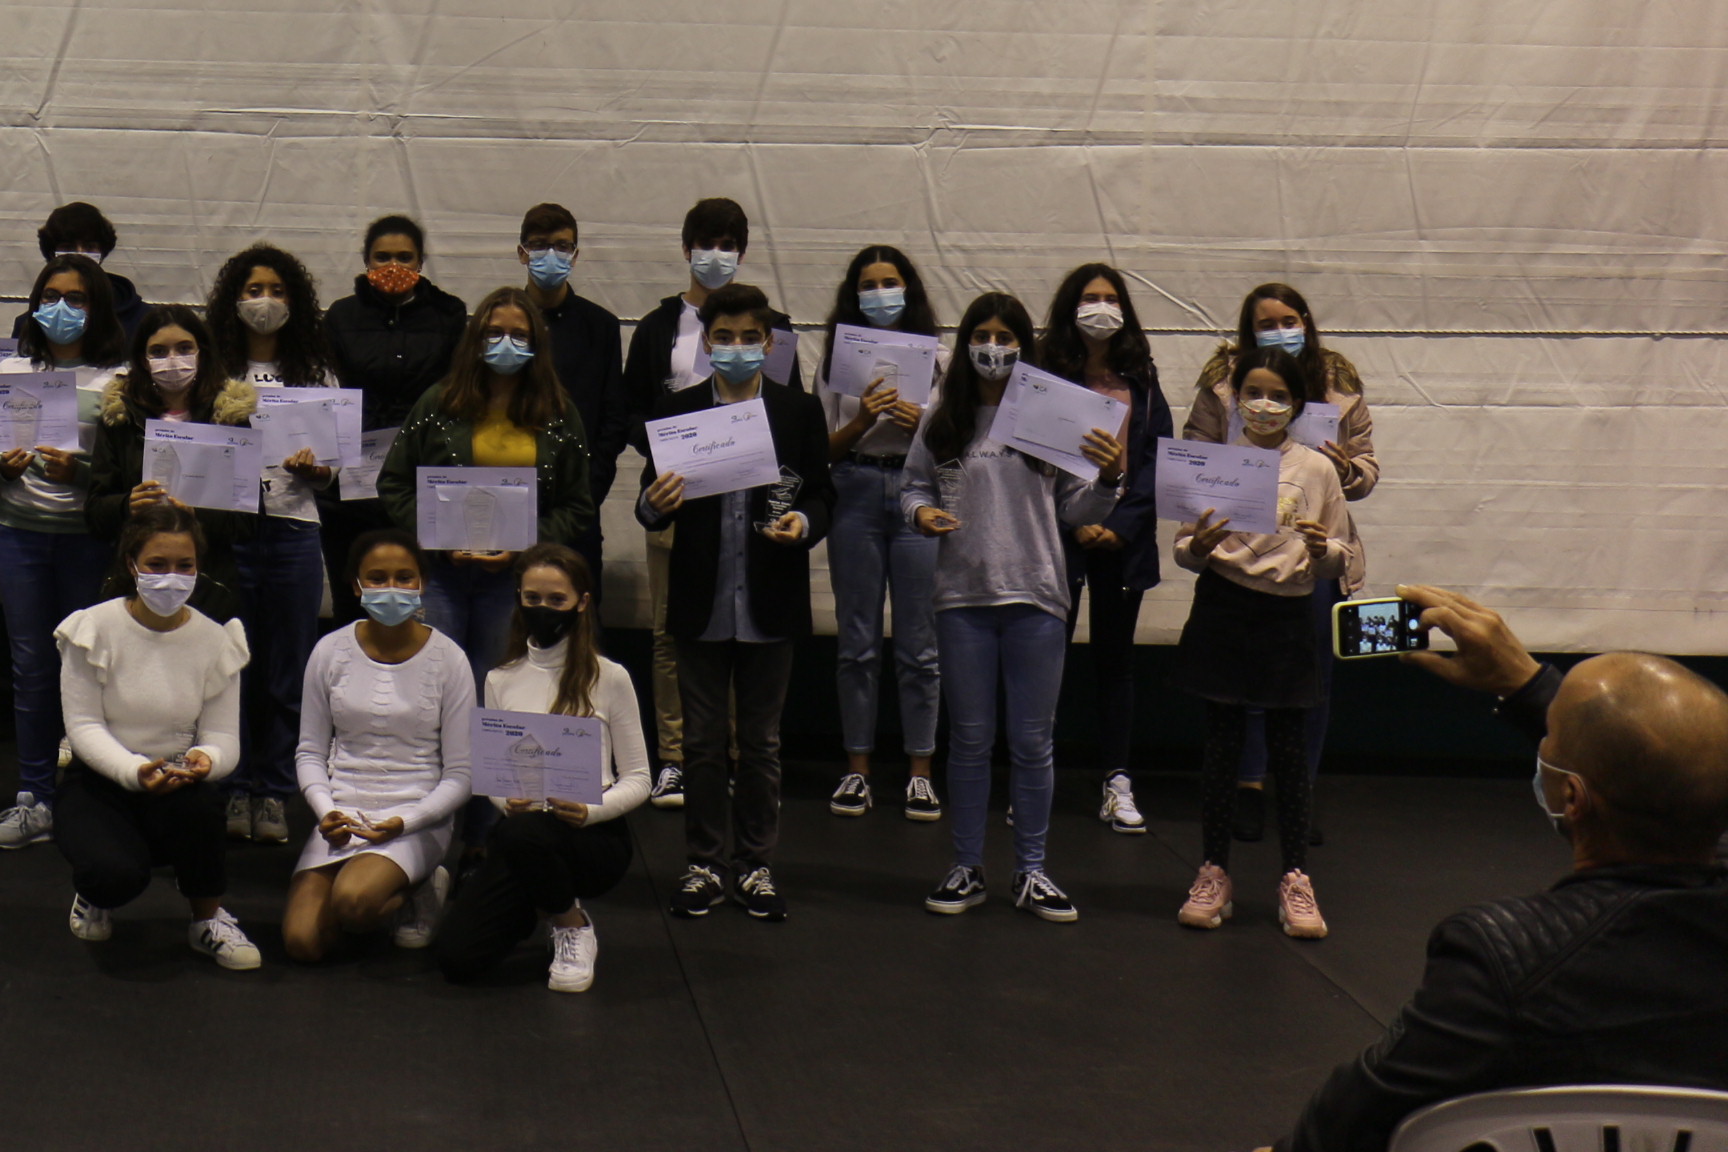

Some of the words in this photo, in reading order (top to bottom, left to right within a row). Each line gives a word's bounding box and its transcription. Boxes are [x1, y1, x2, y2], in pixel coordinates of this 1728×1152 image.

[2, 400, 42, 411] Certificado
[692, 436, 735, 454] Certificado
[1195, 473, 1240, 487] Certificado
[514, 744, 562, 759] Certificado
